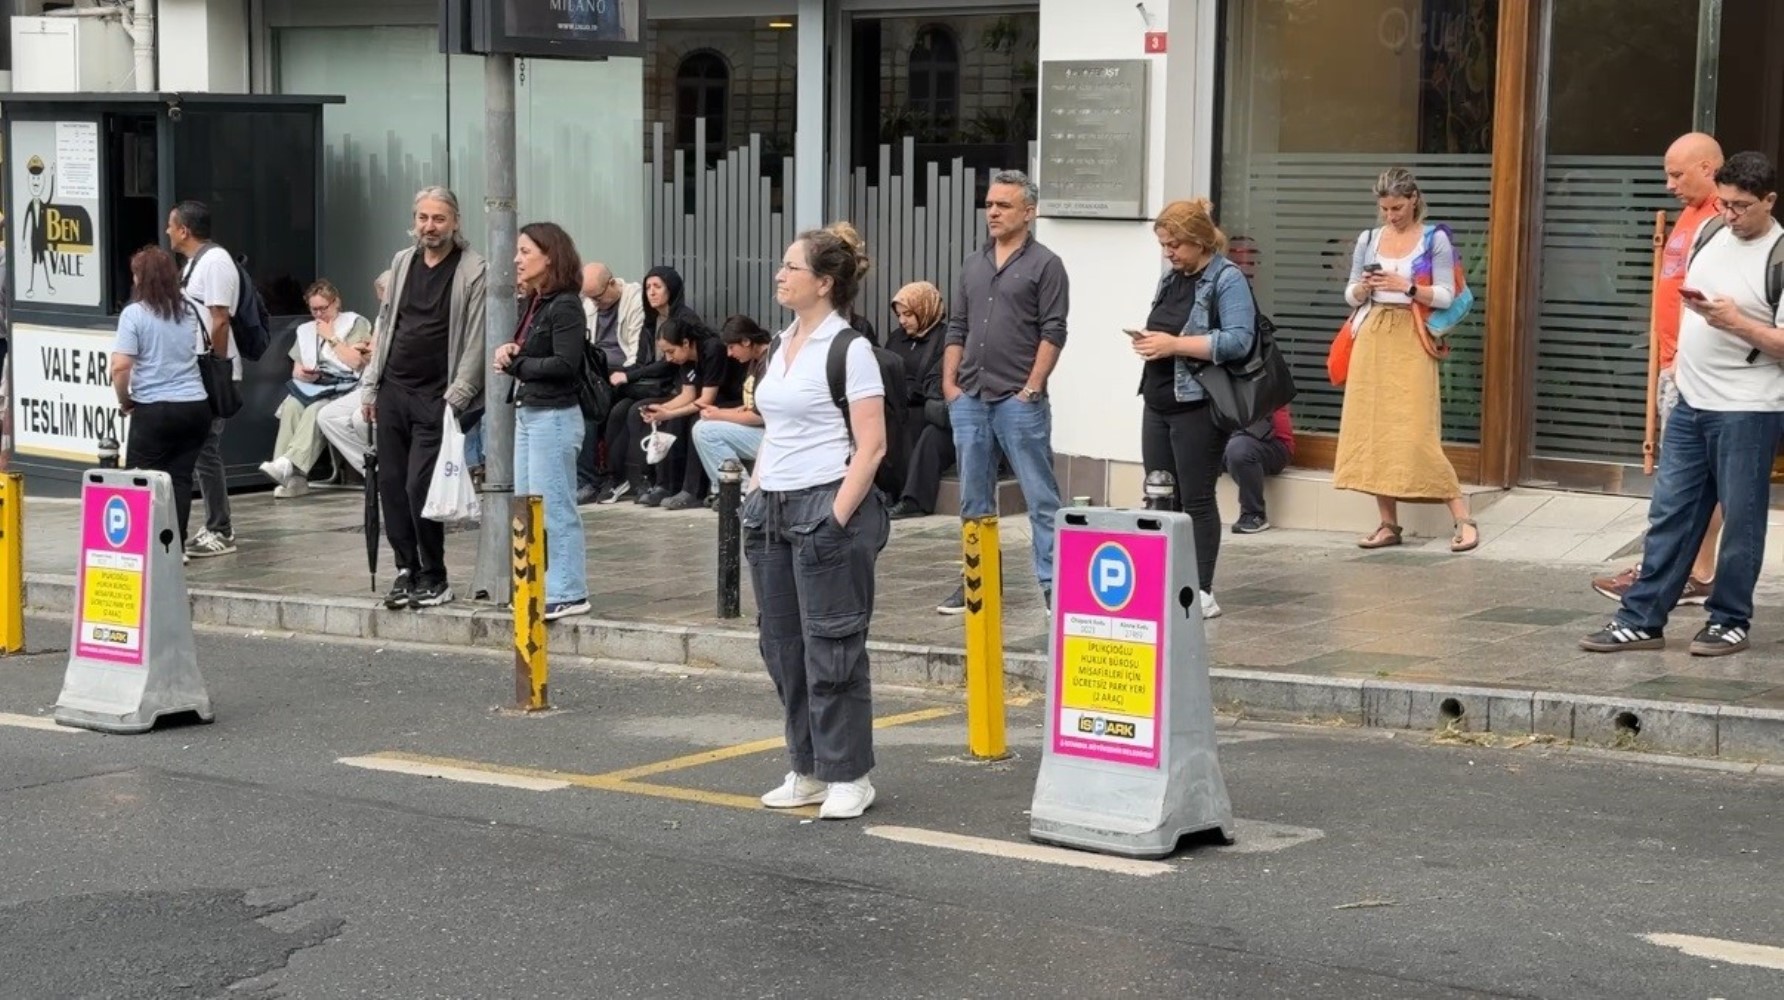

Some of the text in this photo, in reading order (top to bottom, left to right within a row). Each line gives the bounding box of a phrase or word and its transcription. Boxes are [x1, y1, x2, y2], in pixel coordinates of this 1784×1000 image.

[550, 0, 606, 13] MILANO
[1151, 36, 1159, 49] 3
[46, 208, 81, 242] BEN
[47, 243, 85, 277] VALE
[41, 346, 82, 384] VALE
[21, 393, 78, 437] TESLİM
[110, 508, 126, 533] P
[1100, 558, 1126, 592] P
[1081, 654, 1140, 669] HUKUK BÜROSU
[1072, 676, 1146, 694] ÜCRETSİZ PARK YERİ
[1125, 670, 1141, 682] İÇİN
